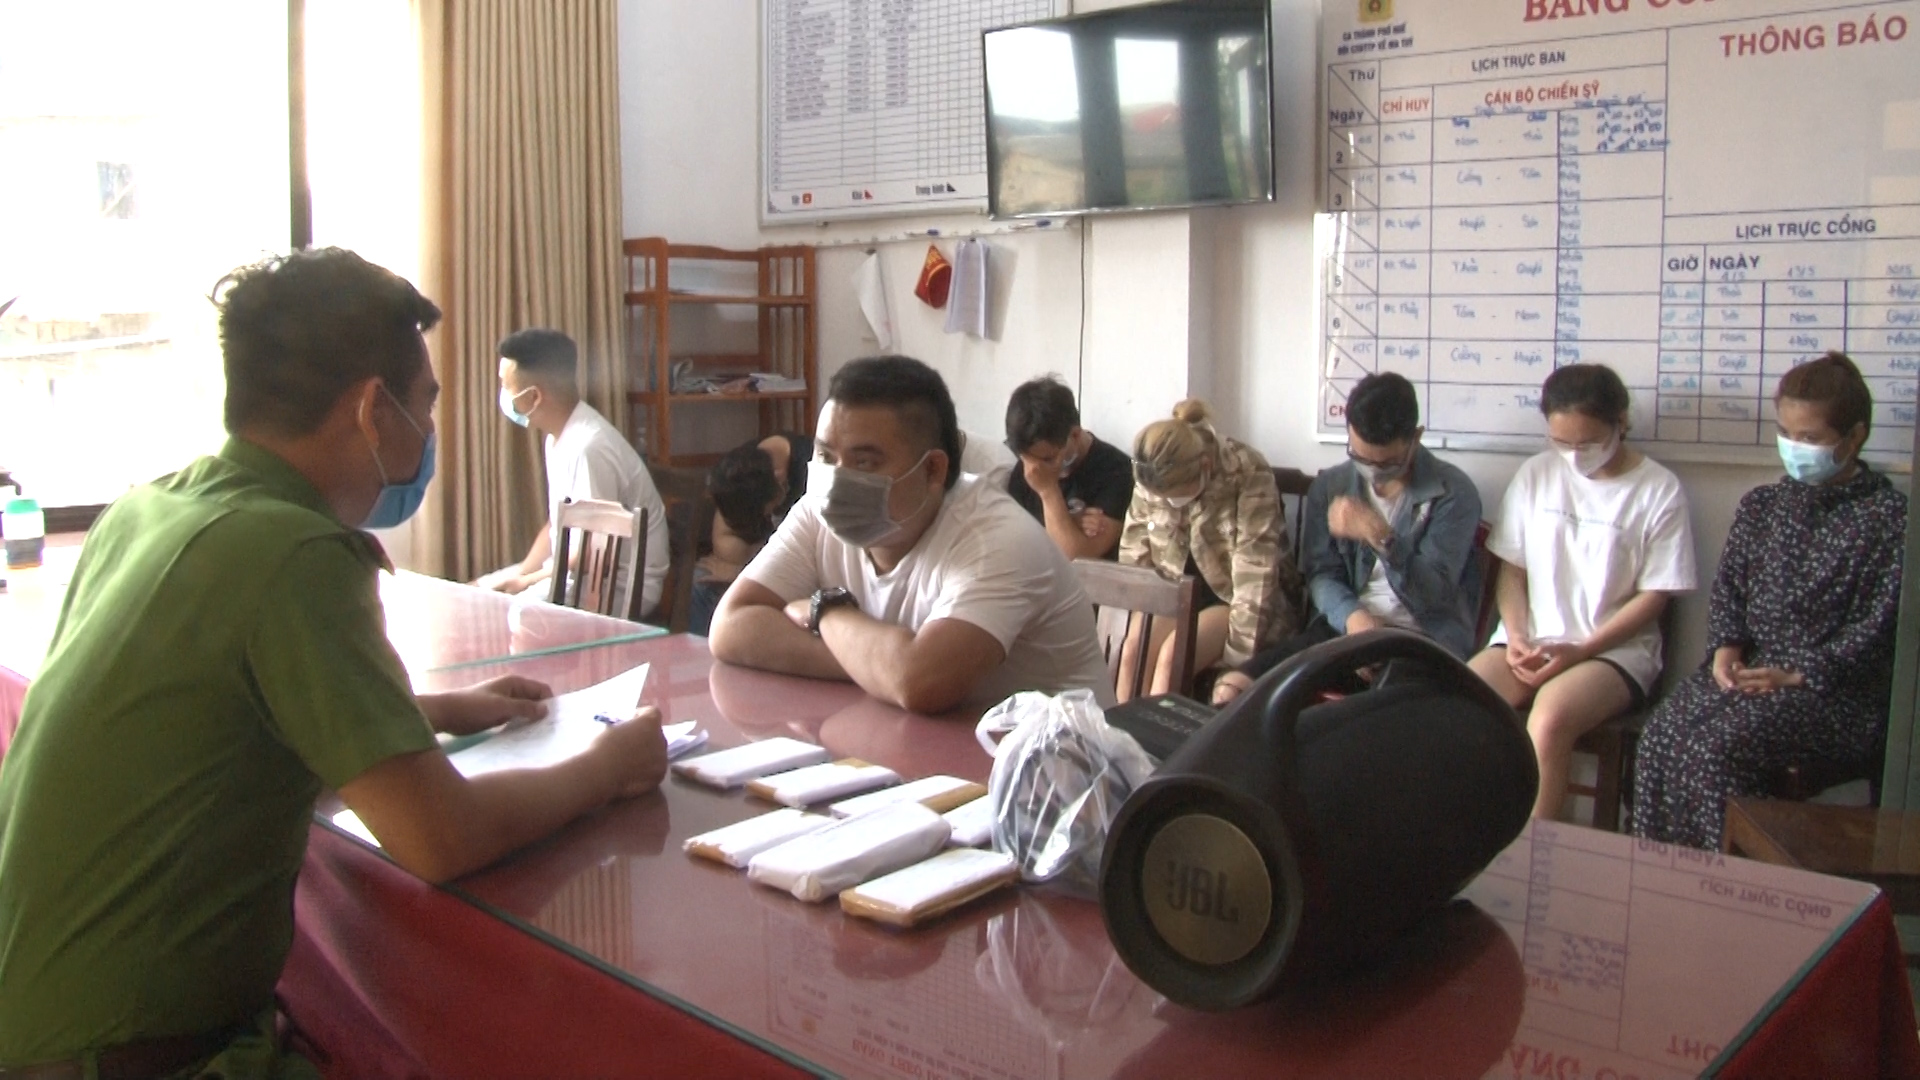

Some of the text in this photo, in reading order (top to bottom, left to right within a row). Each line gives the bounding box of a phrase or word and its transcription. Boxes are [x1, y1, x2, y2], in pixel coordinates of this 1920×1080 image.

[1719, 12, 1907, 57] THÔNG BÁO
[1472, 51, 1566, 73] LỊCH TRỰC BAN
[1515, 86, 1534, 104] BỘ
[1537, 80, 1579, 99] CHIẾN
[1406, 98, 1430, 111] HUY
[1330, 107, 1364, 123] Ngày
[1336, 151, 1343, 165] 2
[1334, 193, 1343, 207] 3
[1736, 214, 1876, 241] LỊCH TRỰC CỔNG
[1667, 253, 1760, 271] GIỜ NGÀY
[1332, 316, 1341, 329] 6
[1333, 358, 1341, 371] 7
[1167, 860, 1240, 923] JBL
